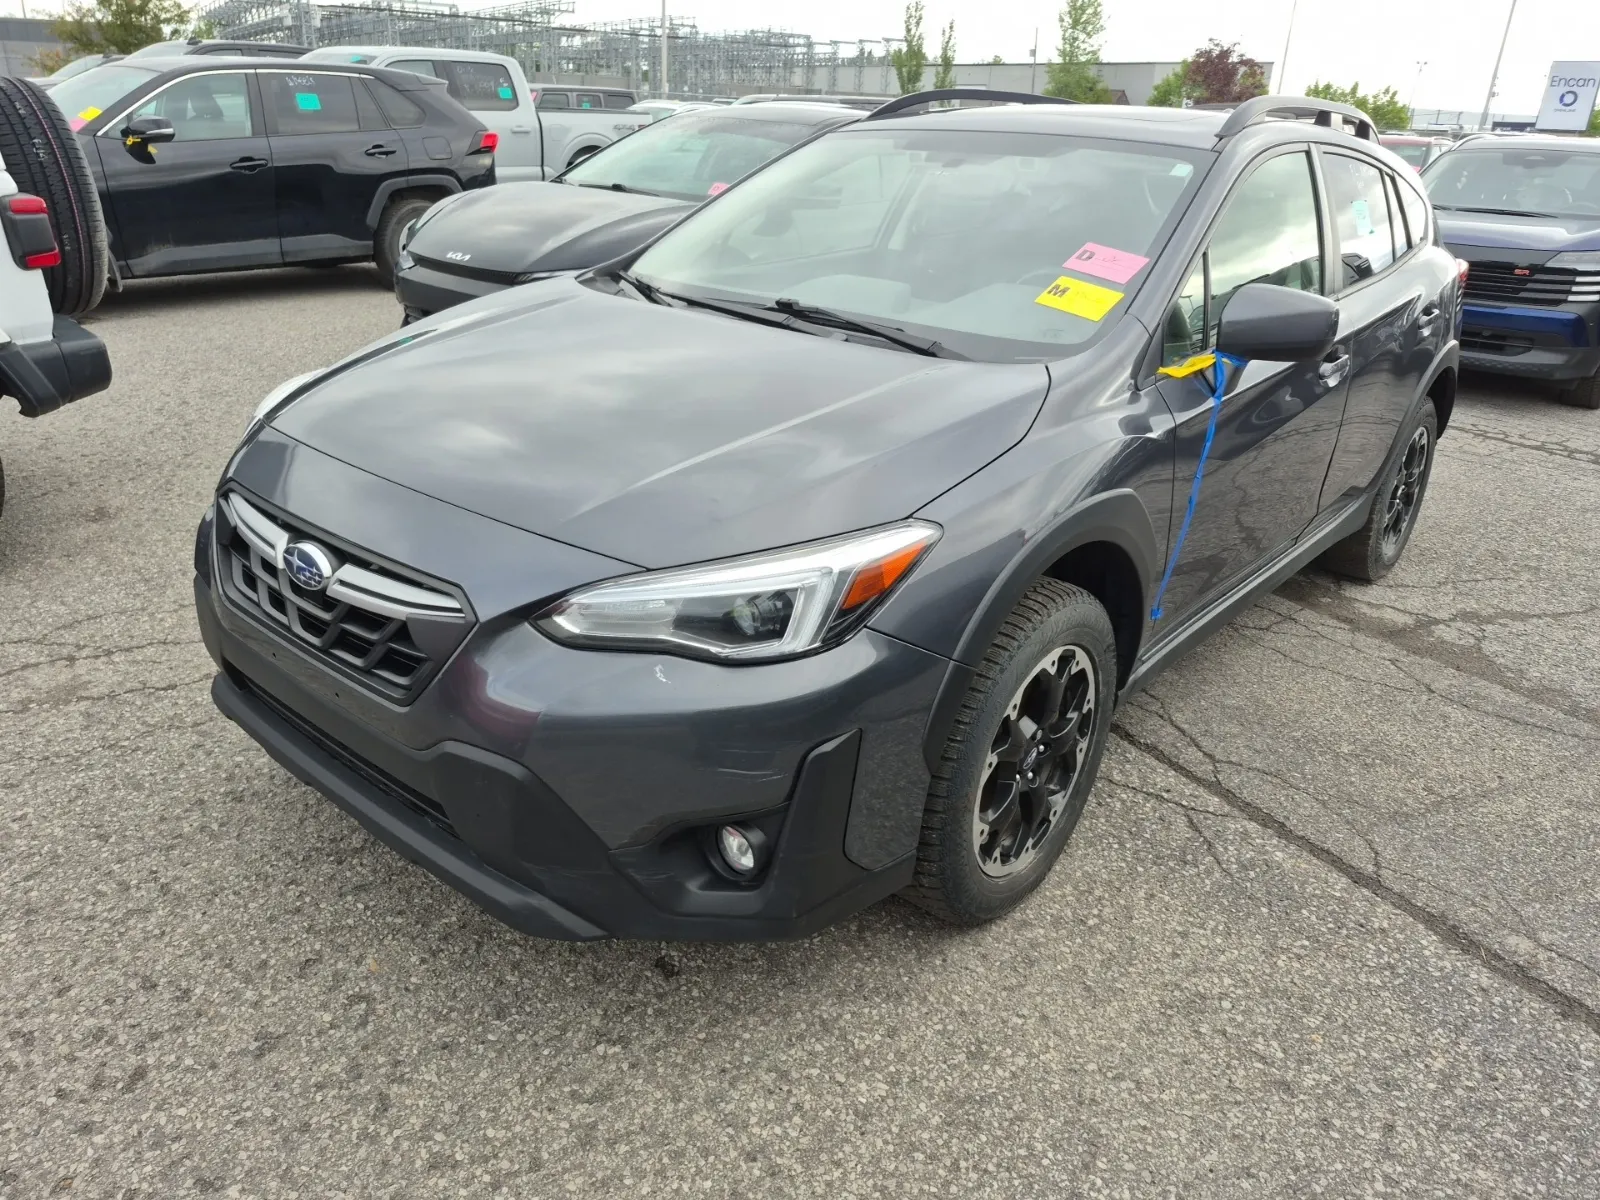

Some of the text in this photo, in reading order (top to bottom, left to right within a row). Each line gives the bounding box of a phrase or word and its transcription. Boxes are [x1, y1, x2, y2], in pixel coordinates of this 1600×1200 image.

[1550, 76, 1596, 88] Encan
[446, 251, 472, 262] KIA
[1075, 249, 1096, 261] D
[1046, 283, 1071, 298] M
